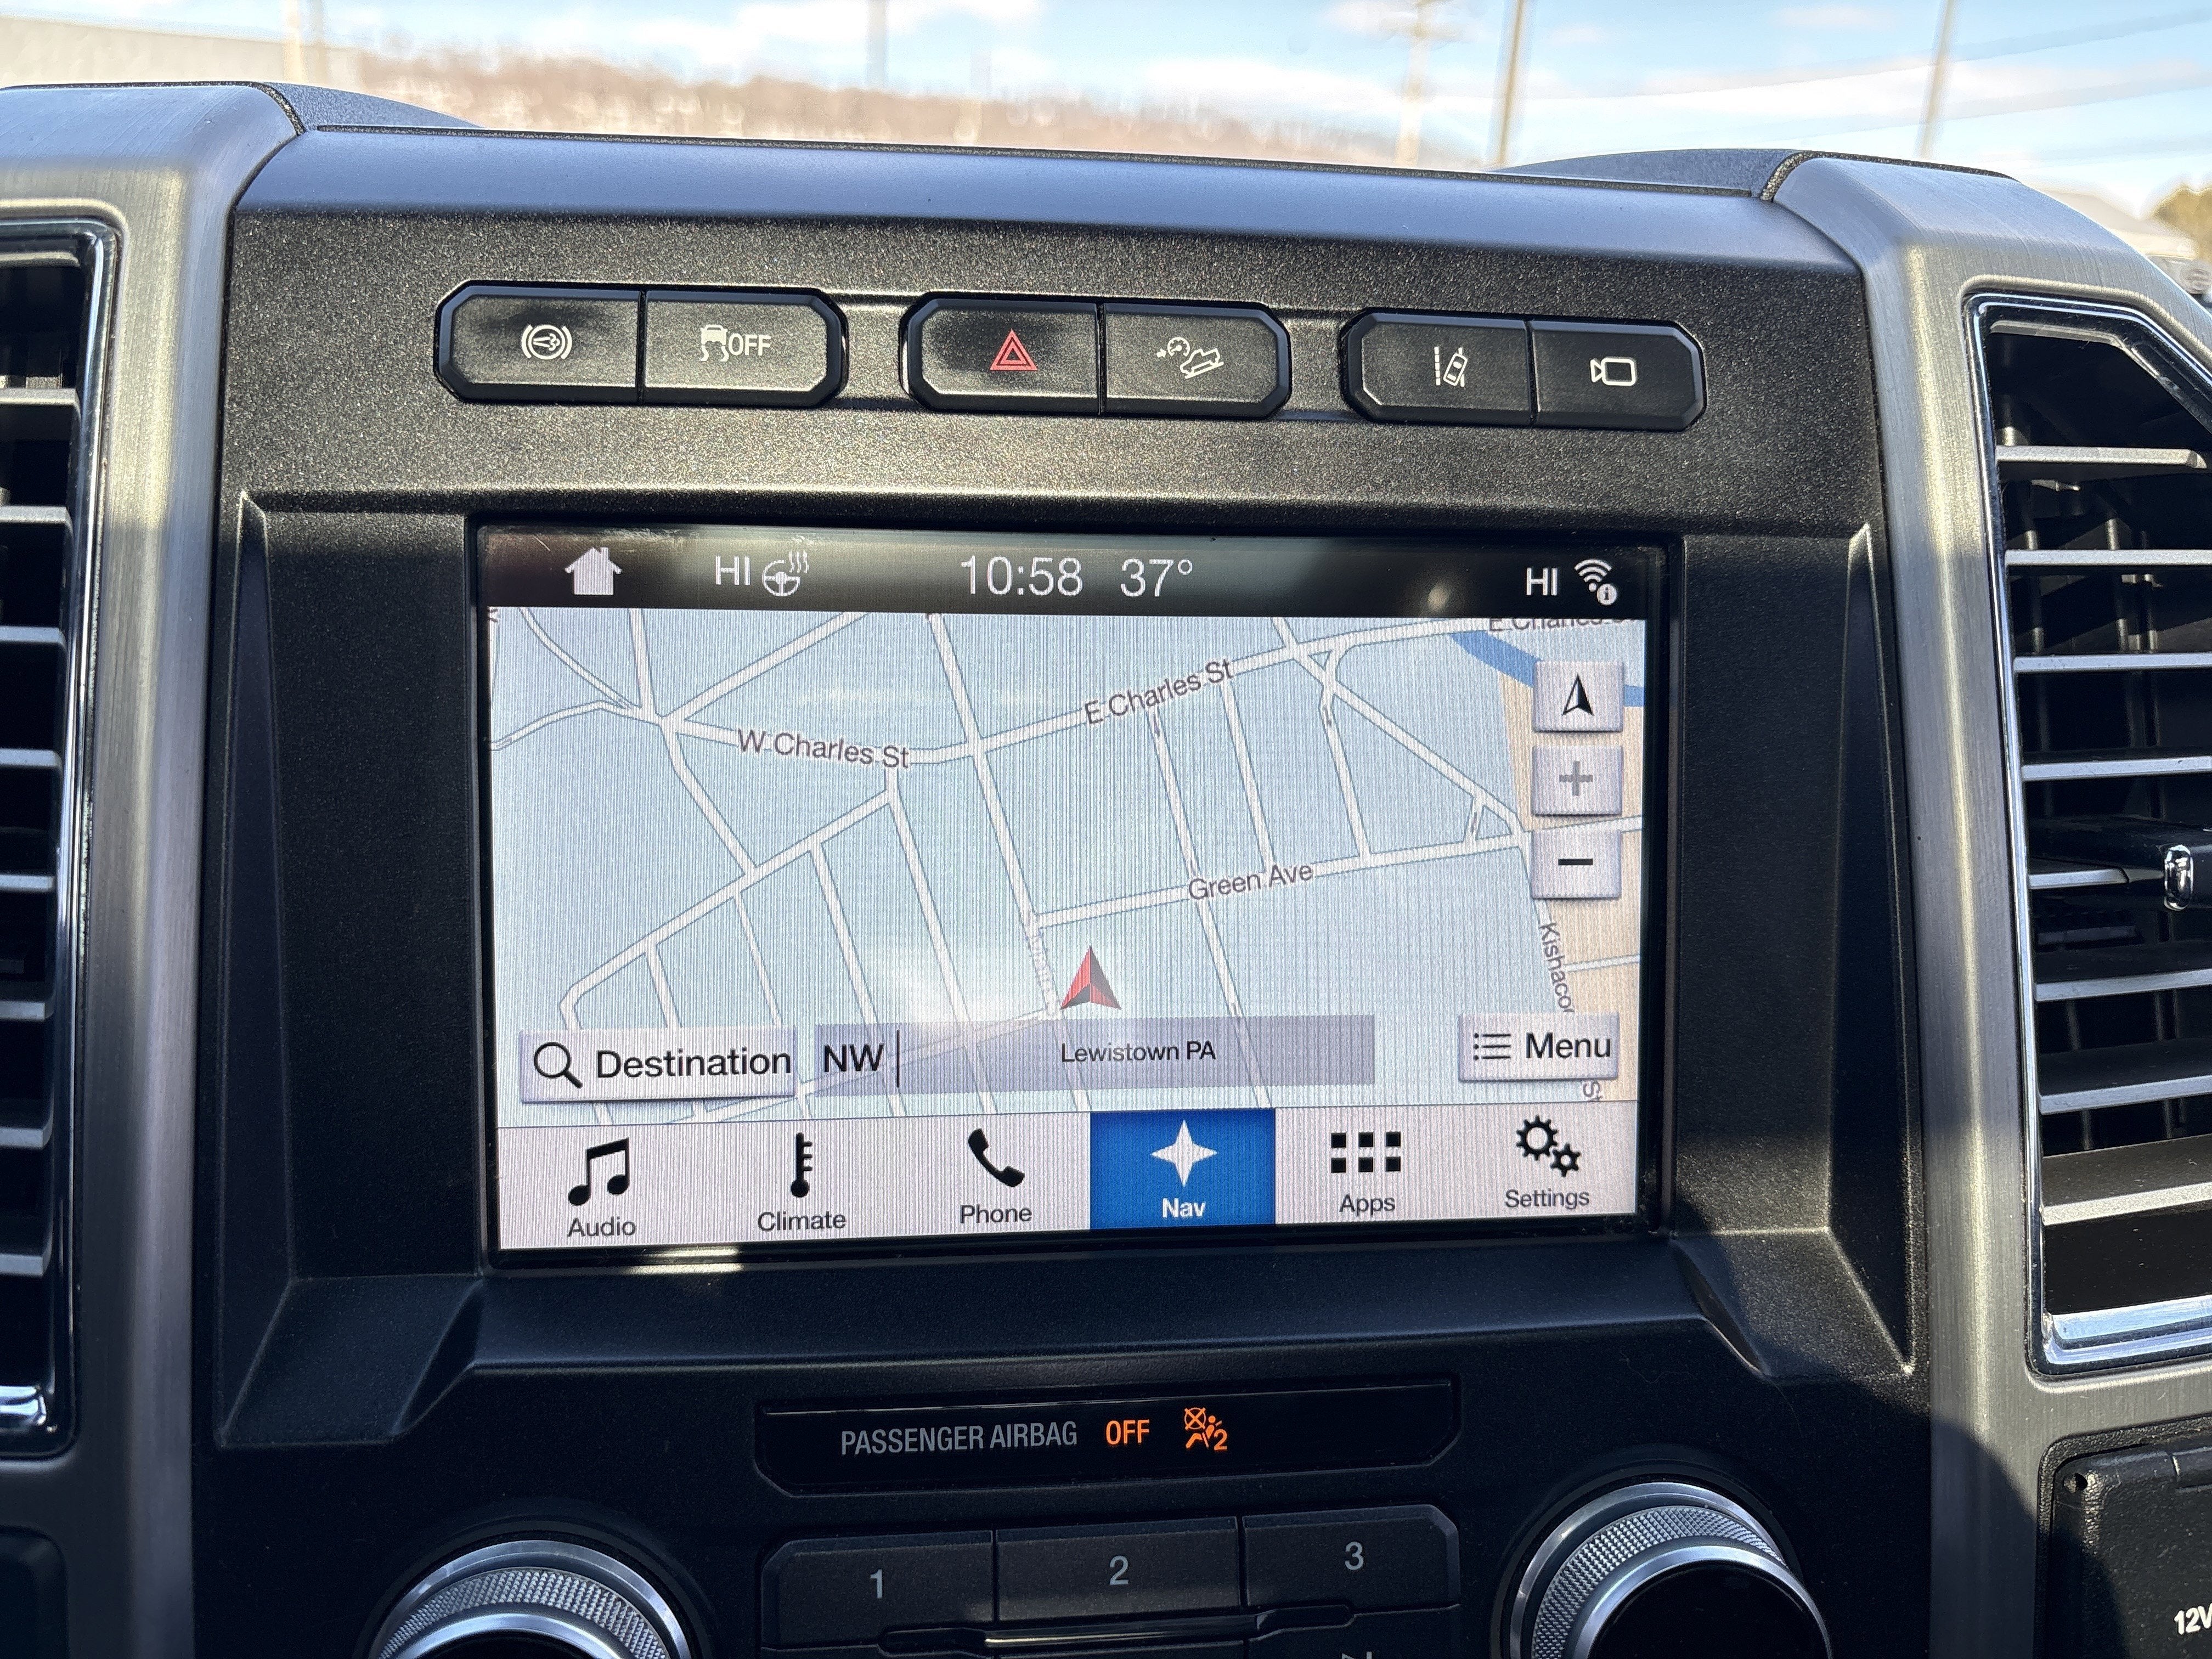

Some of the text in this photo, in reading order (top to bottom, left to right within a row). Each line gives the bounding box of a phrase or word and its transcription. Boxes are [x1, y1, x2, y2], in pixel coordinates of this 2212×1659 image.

[727, 332, 771, 357] OFF
[715, 555, 750, 586] HI
[961, 555, 1084, 597] 10:58
[1120, 558, 1194, 597] 37°
[1526, 567, 1558, 596] HI
[1083, 657, 1234, 725] E Charles St
[737, 728, 910, 769] W Charles St
[1188, 863, 1313, 901] Green Ave
[1538, 922, 1575, 1013] Kishaco
[823, 1043, 884, 1073] NW
[1060, 1040, 1217, 1063] Lewistown PA
[1525, 1031, 1611, 1059] Menu
[596, 1047, 792, 1080] Destination
[960, 1203, 1032, 1224] Phone
[1162, 1197, 1206, 1218] Nav
[1339, 1193, 1396, 1217] Apps
[1505, 1188, 1590, 1210] Settings
[567, 1216, 636, 1238] Audio
[757, 1210, 847, 1233] Climate
[841, 1425, 984, 1455] PASSENGER
[989, 1420, 1078, 1449] AIRBAG
[1105, 1419, 1150, 1446] OFF
[1108, 1555, 1130, 1587] 2
[1344, 1541, 1365, 1571] 3
[870, 1568, 884, 1599] 1
